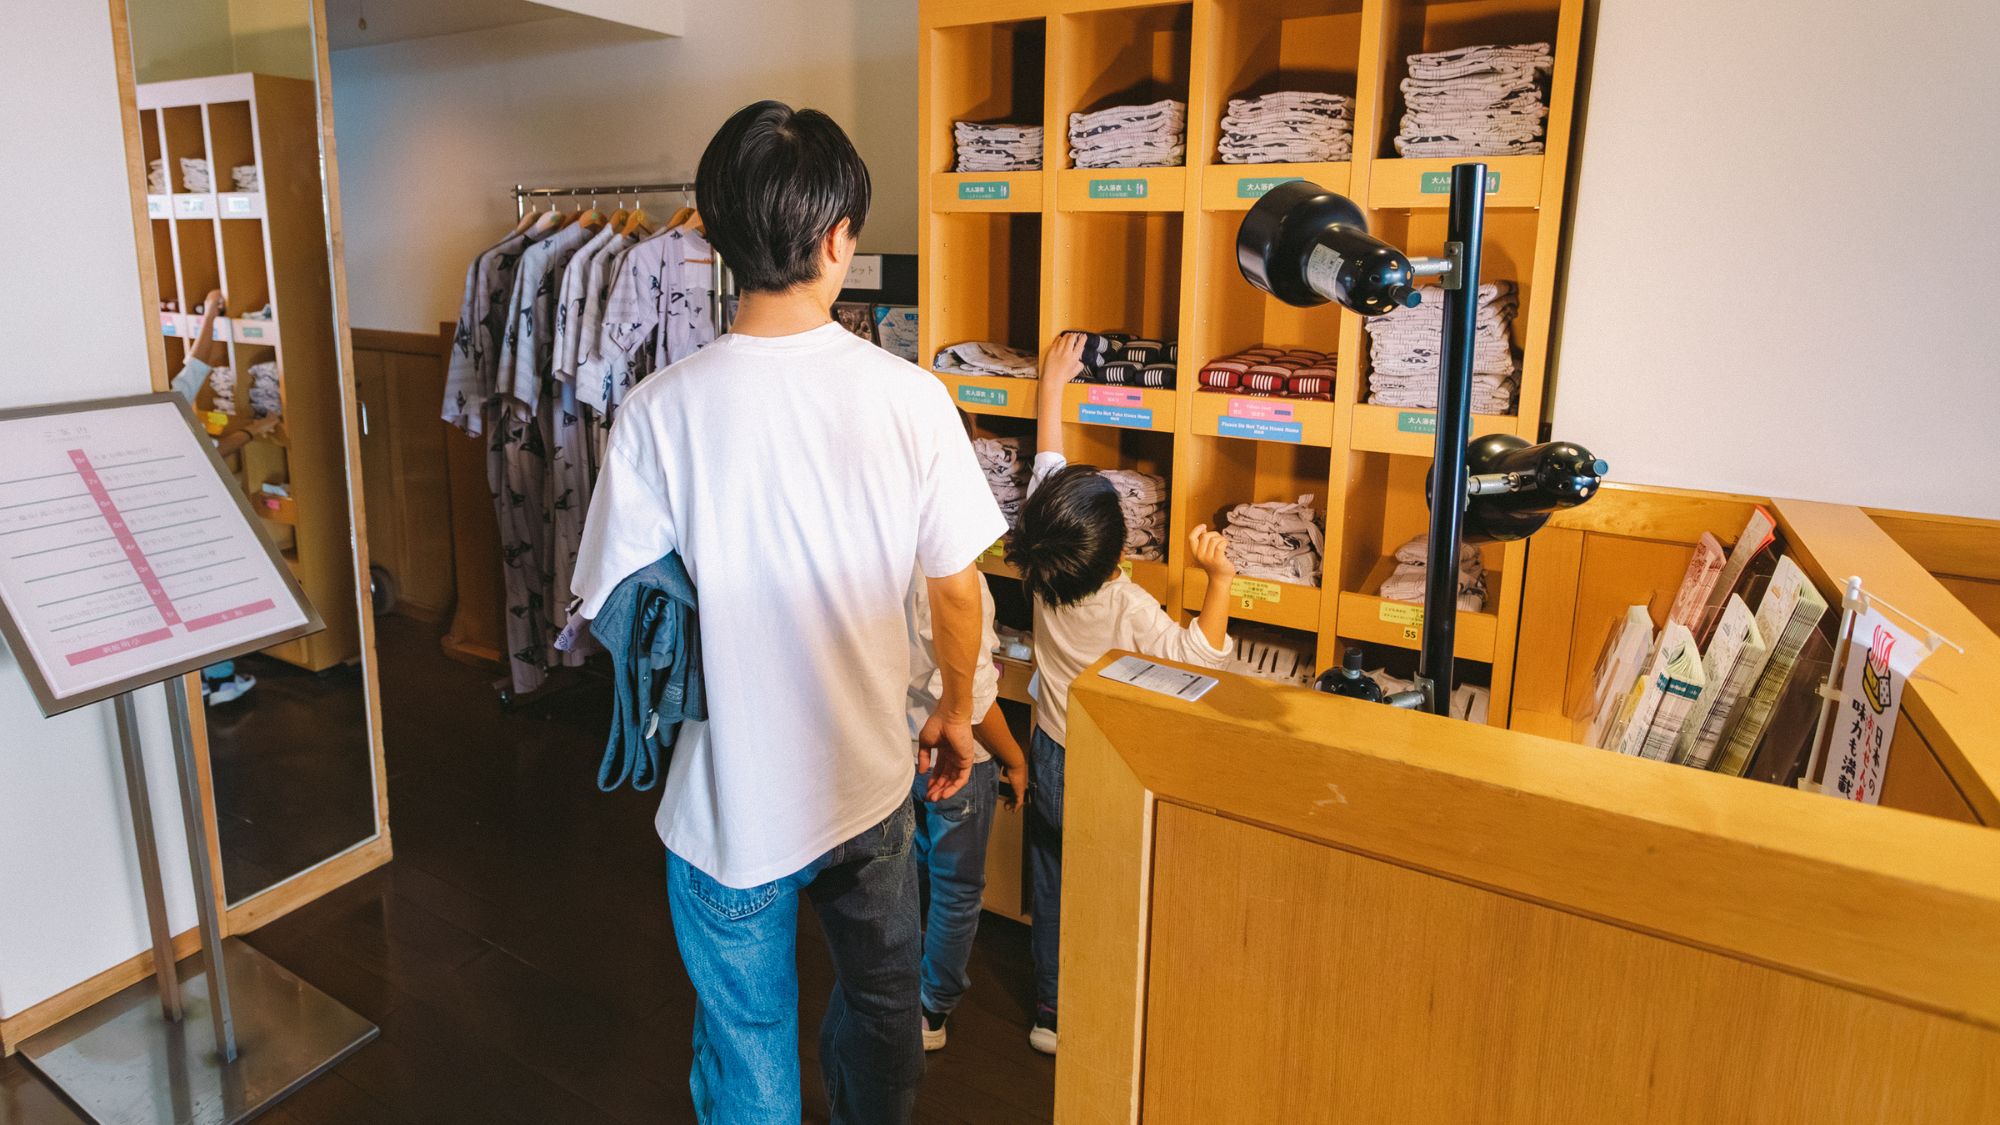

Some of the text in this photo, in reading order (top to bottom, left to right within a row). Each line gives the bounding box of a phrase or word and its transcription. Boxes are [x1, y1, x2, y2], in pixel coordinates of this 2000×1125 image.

[1244, 600, 1250, 608] S
[1404, 629, 1417, 640] SS
[1869, 725, 1883, 797] 日本一の
